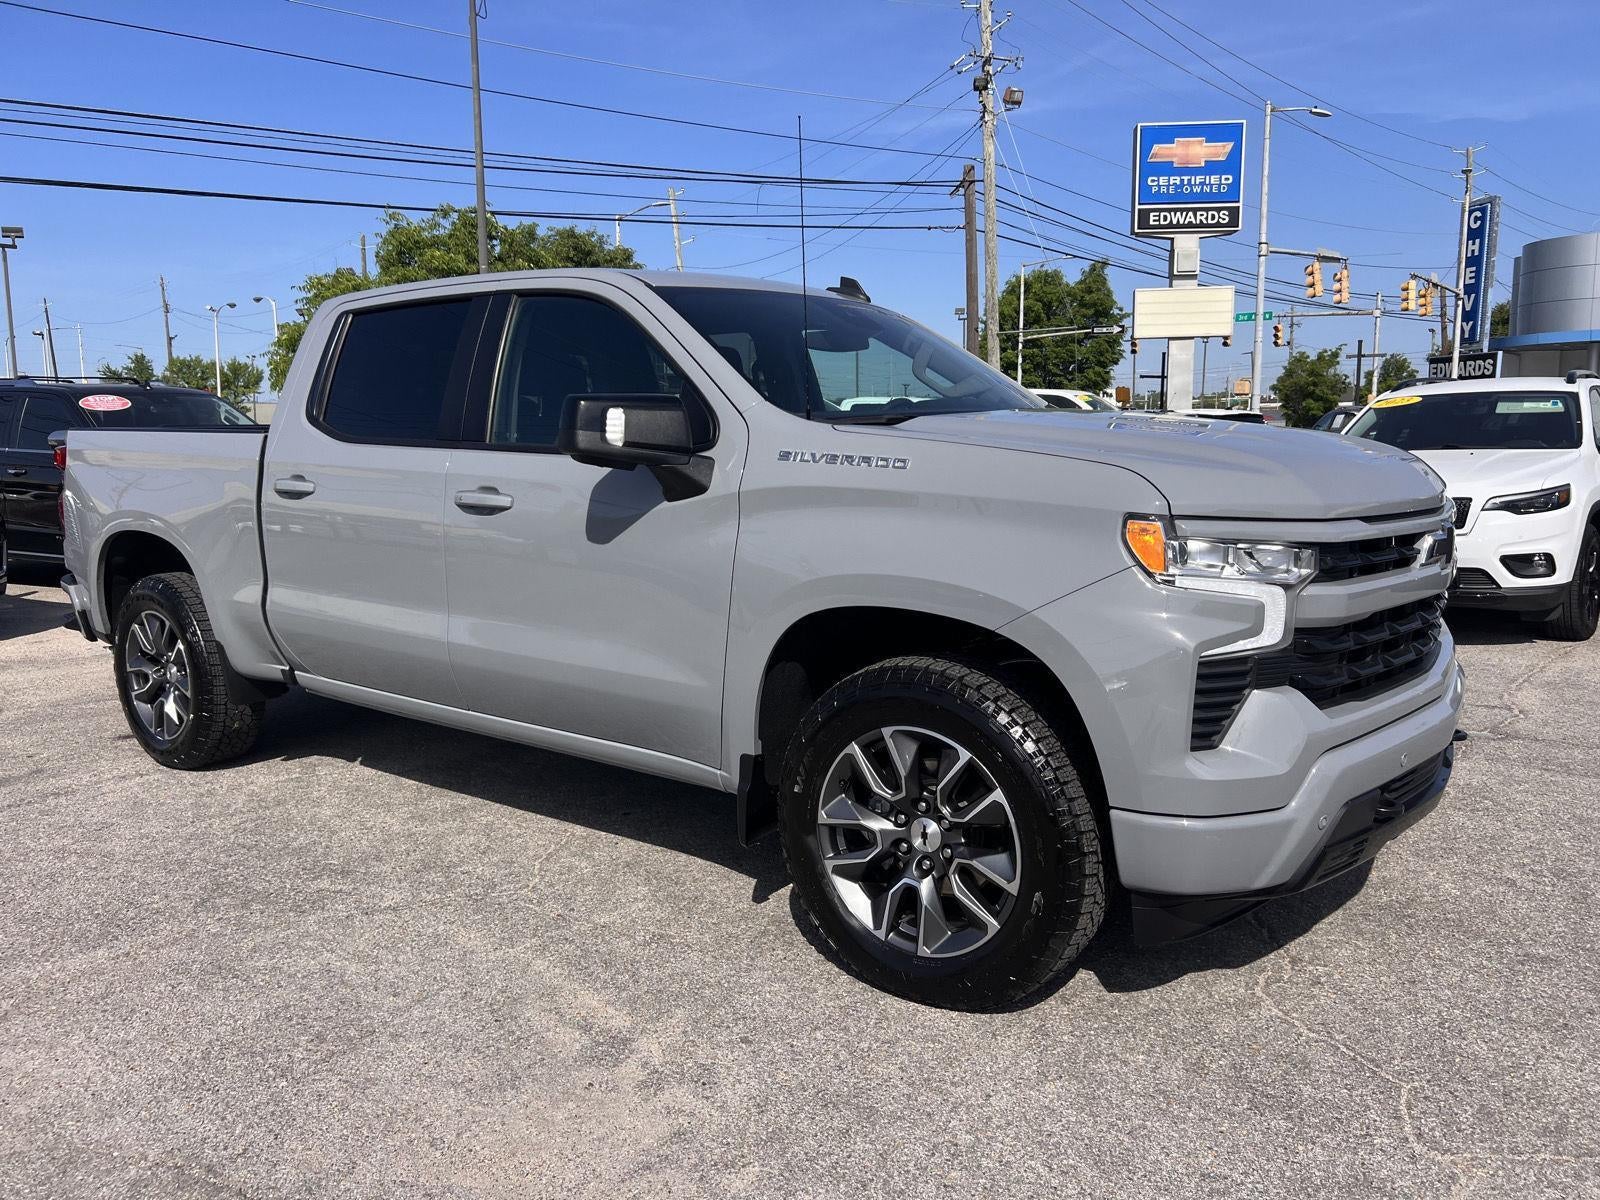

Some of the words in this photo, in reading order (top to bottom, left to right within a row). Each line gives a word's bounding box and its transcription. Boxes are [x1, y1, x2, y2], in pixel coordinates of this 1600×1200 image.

[1147, 175, 1233, 186] CERTIFIED
[1152, 185, 1228, 194] PRE-OWNED
[1149, 210, 1230, 225] EDWARDS
[1461, 210, 1482, 339] CHEVY
[1238, 313, 1248, 321] 3rd
[777, 450, 910, 470] SILVERADO
